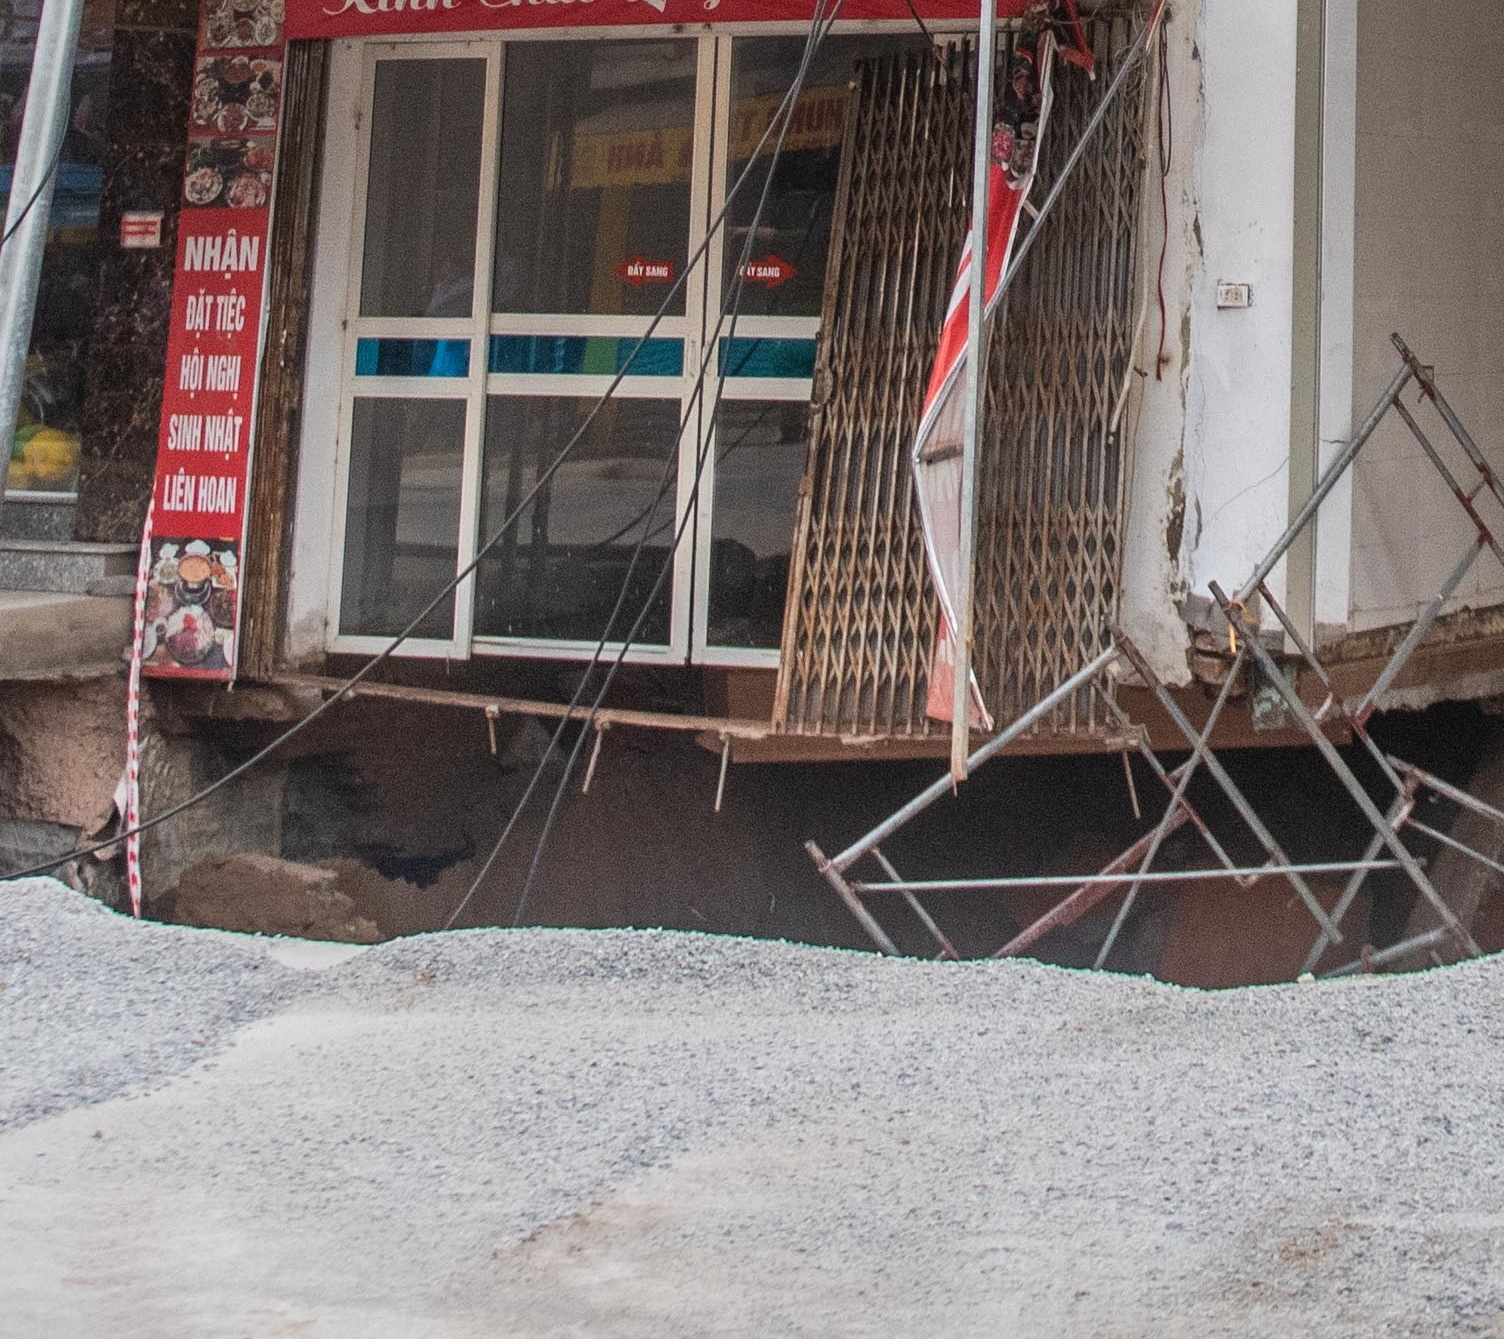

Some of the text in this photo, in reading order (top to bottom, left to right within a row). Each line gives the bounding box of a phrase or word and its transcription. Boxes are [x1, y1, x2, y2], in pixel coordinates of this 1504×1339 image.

[183, 228, 260, 280] NHẬN
[185, 286, 246, 339] ĐẶT TIỆC
[179, 346, 242, 400] HỘI NGHỊ
[167, 407, 243, 461] SINH NHẬT
[163, 467, 238, 514] LIÊN HOAN
